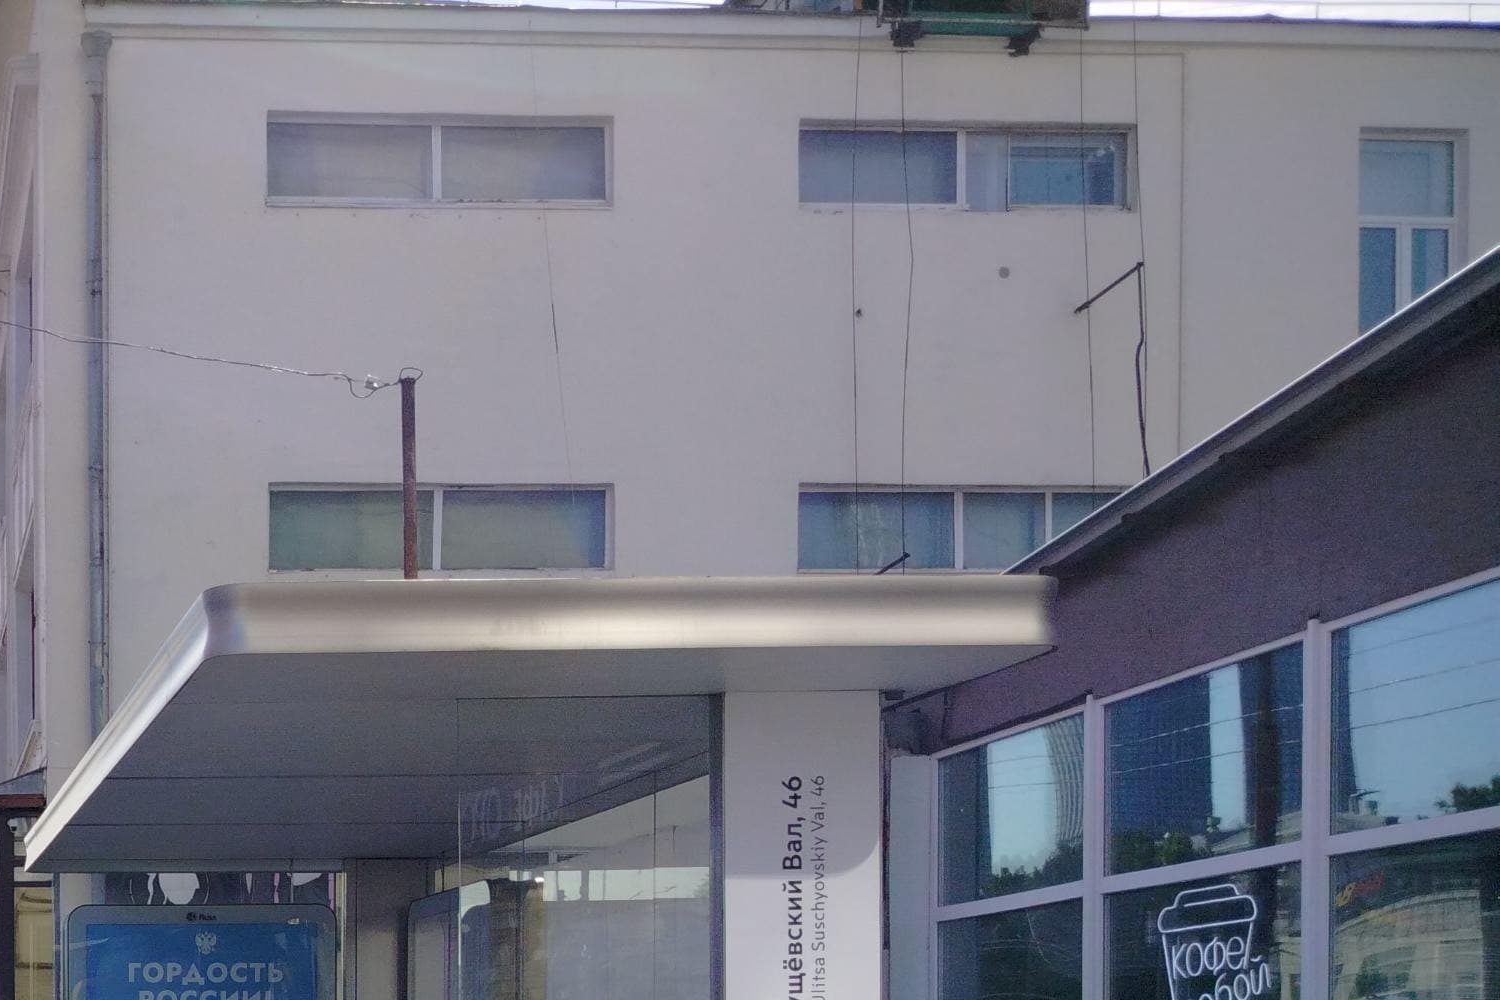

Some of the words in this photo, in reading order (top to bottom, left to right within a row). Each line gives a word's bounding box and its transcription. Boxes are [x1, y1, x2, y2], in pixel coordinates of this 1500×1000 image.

[782, 775, 803, 809] 46
[811, 775, 826, 797] 46
[811, 803, 828, 833] Val,
[782, 816, 807, 870] Вал,
[811, 839, 828, 952] Suschyovskiy
[128, 962, 284, 986] ГОРДОСТЬ
